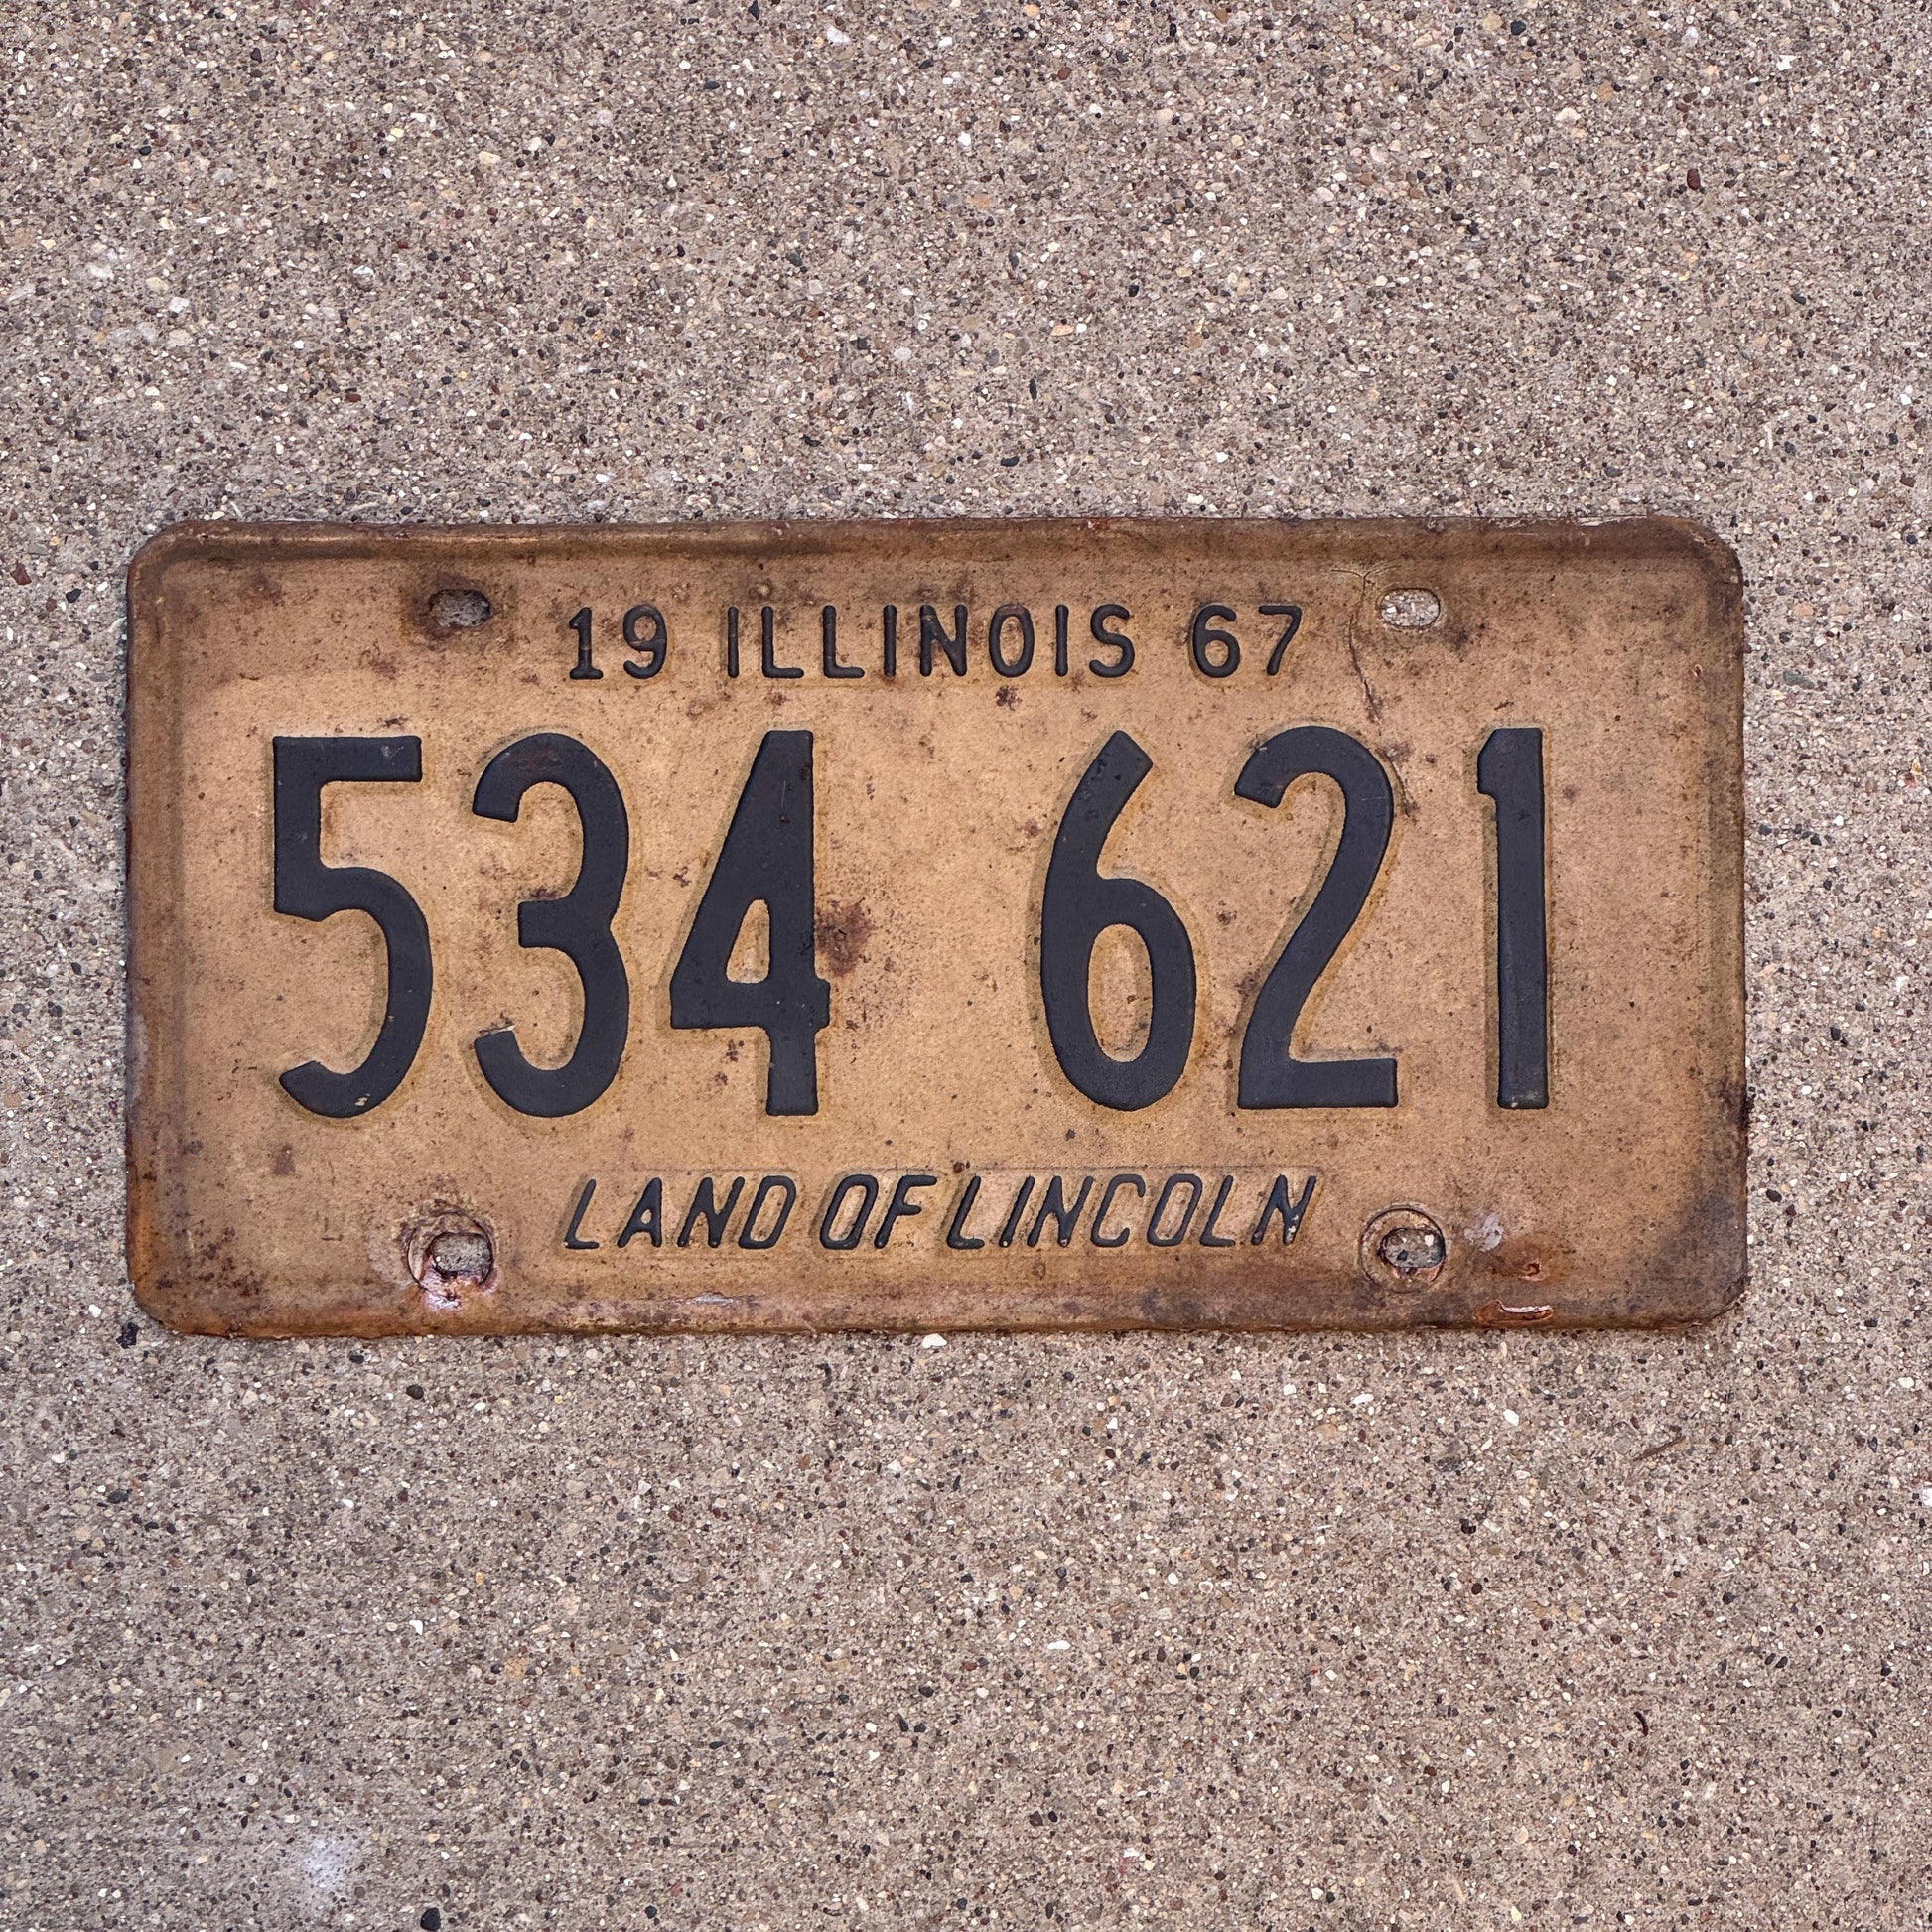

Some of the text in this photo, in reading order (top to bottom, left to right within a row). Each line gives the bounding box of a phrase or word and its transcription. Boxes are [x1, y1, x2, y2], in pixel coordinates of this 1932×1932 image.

[568, 604, 1303, 680] 19 ILLINOIS 67
[271, 726, 1550, 1119] 534 621
[563, 1174, 1317, 1250] LAND OF LINCOLN
